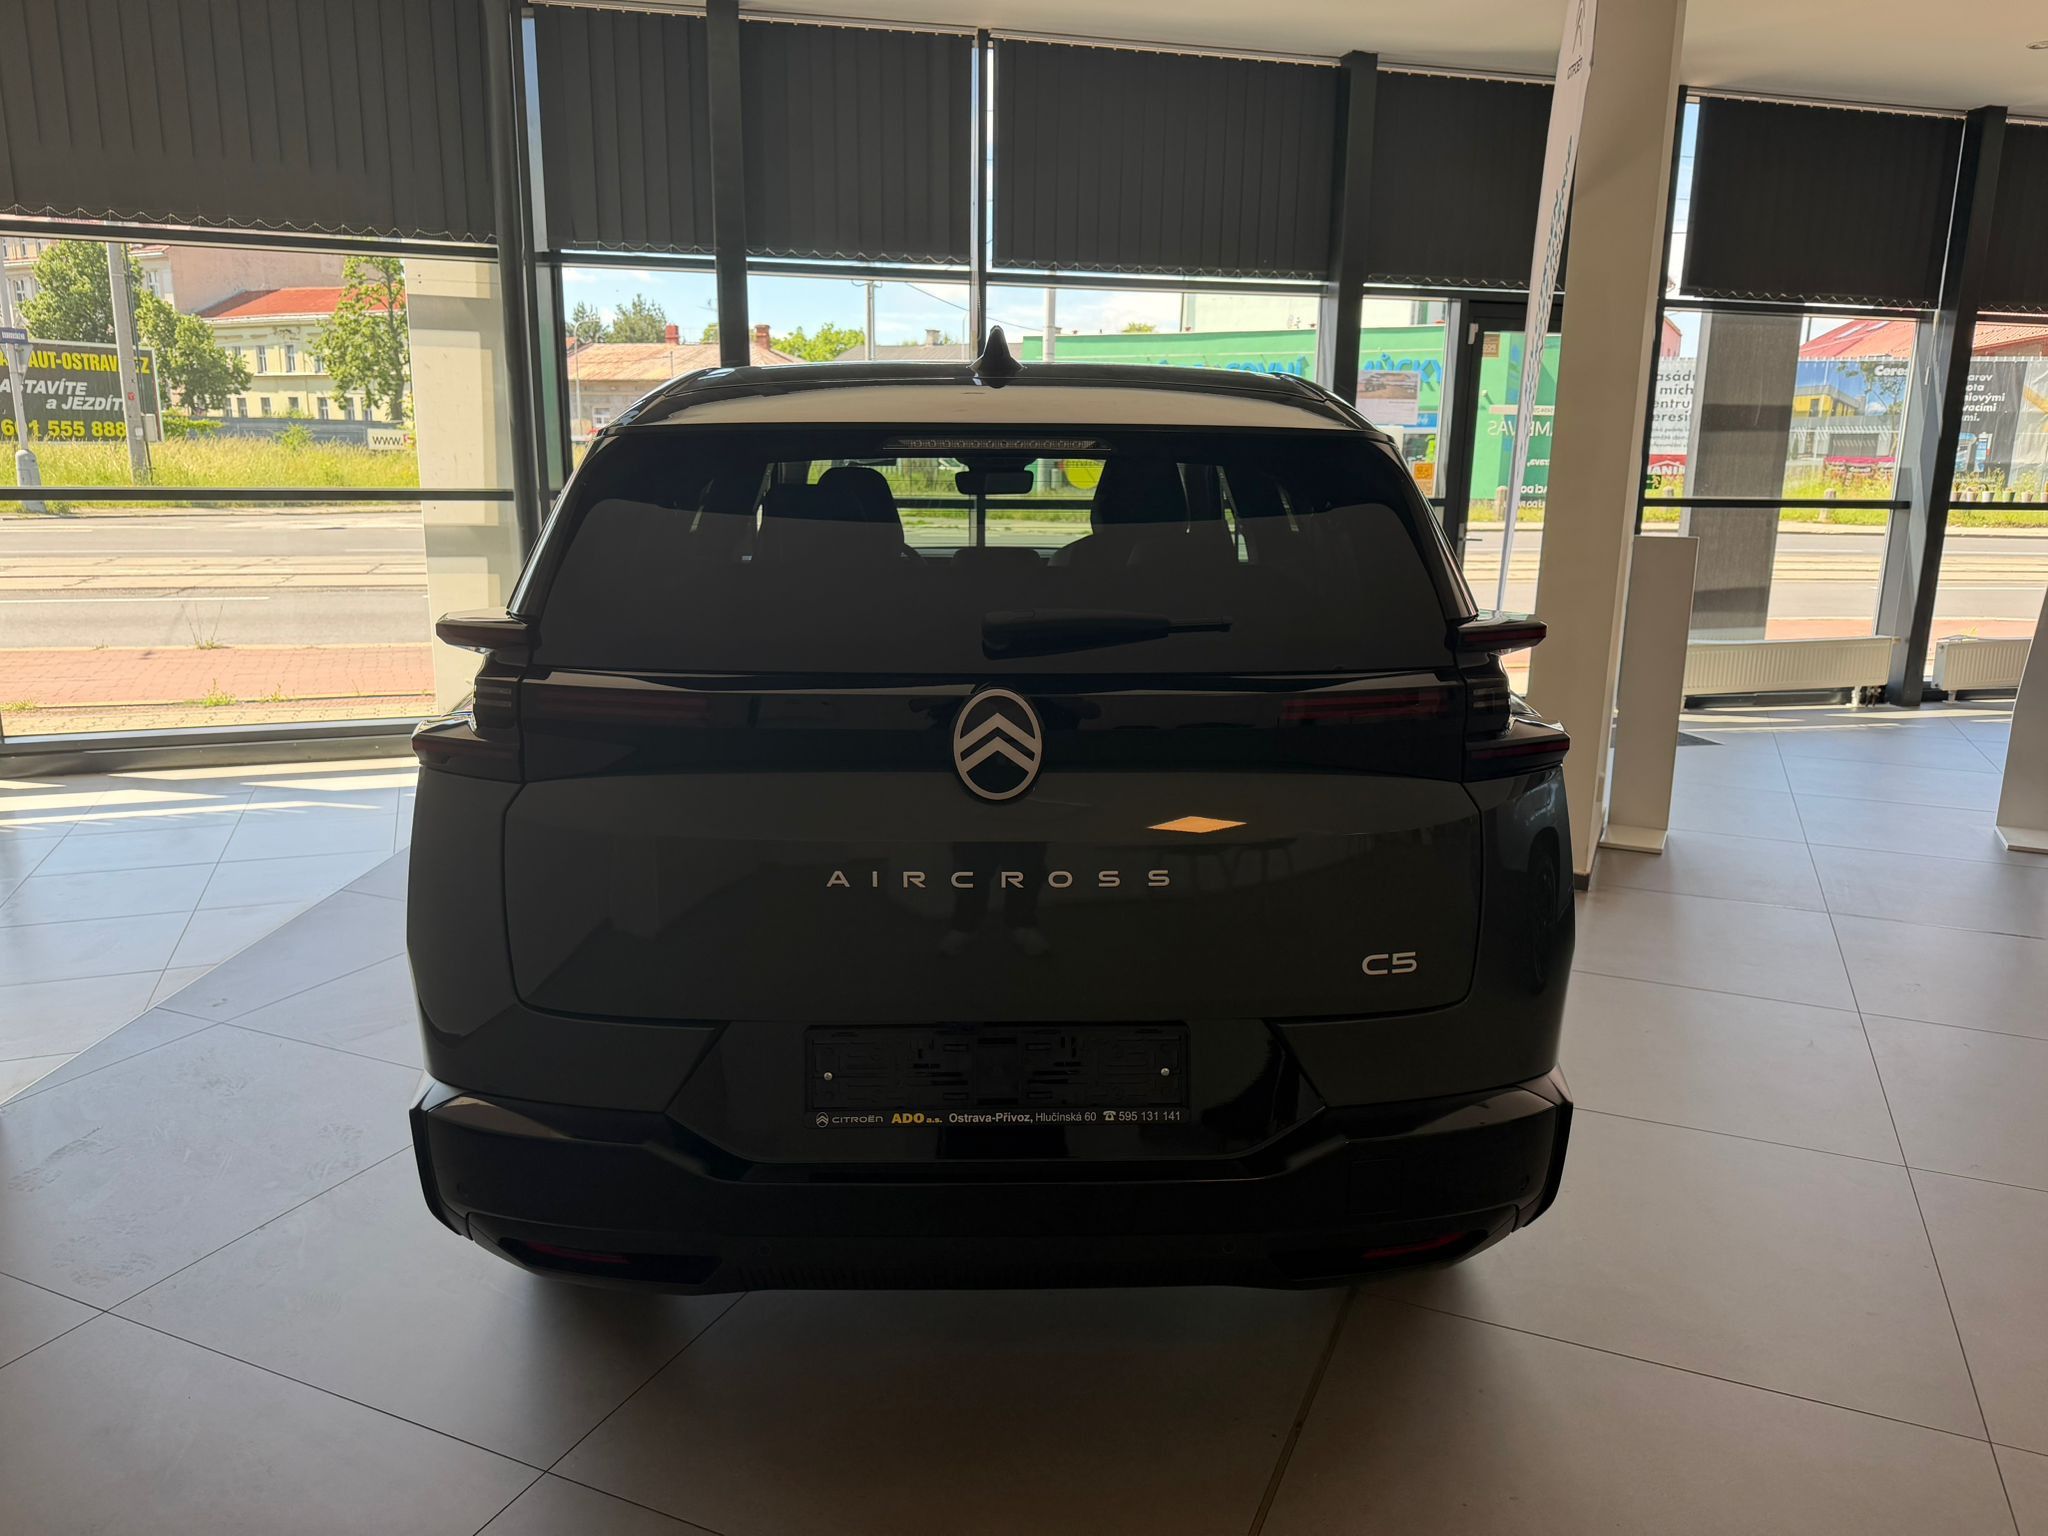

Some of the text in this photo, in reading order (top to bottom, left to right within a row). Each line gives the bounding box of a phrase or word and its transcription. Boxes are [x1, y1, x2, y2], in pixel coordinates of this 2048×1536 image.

[46, 395, 124, 411] a JEZDÍT
[1, 418, 127, 438] 61 555 888
[826, 870, 1171, 889] AIRCROSS
[1361, 951, 1418, 976] C5
[891, 1113, 925, 1125] ADO
[1084, 1112, 1097, 1122] 60
[1118, 1111, 1138, 1121] 595
[1141, 1111, 1160, 1121] 131
[1163, 1111, 1181, 1121] 141
